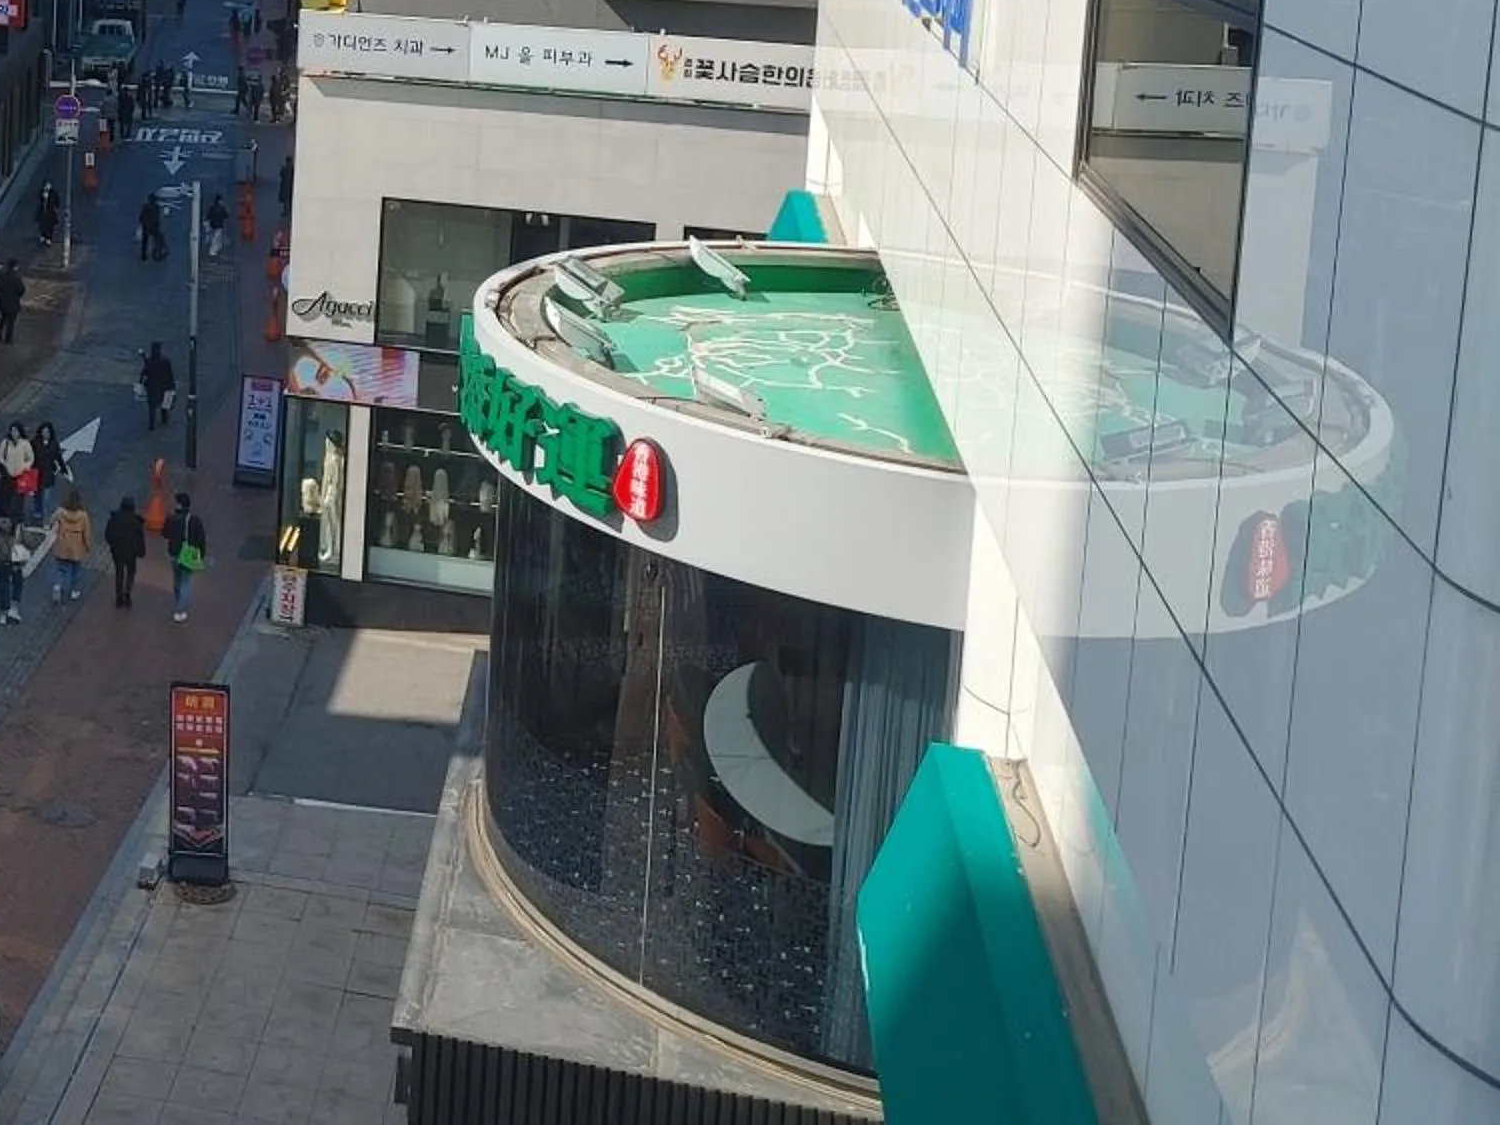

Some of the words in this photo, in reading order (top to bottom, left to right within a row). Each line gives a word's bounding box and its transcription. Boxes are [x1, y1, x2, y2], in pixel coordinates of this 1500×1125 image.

[329, 32, 388, 52] 가디언즈
[393, 37, 425, 56] 치과
[484, 45, 510, 60] MJ
[542, 48, 593, 67] 피부과
